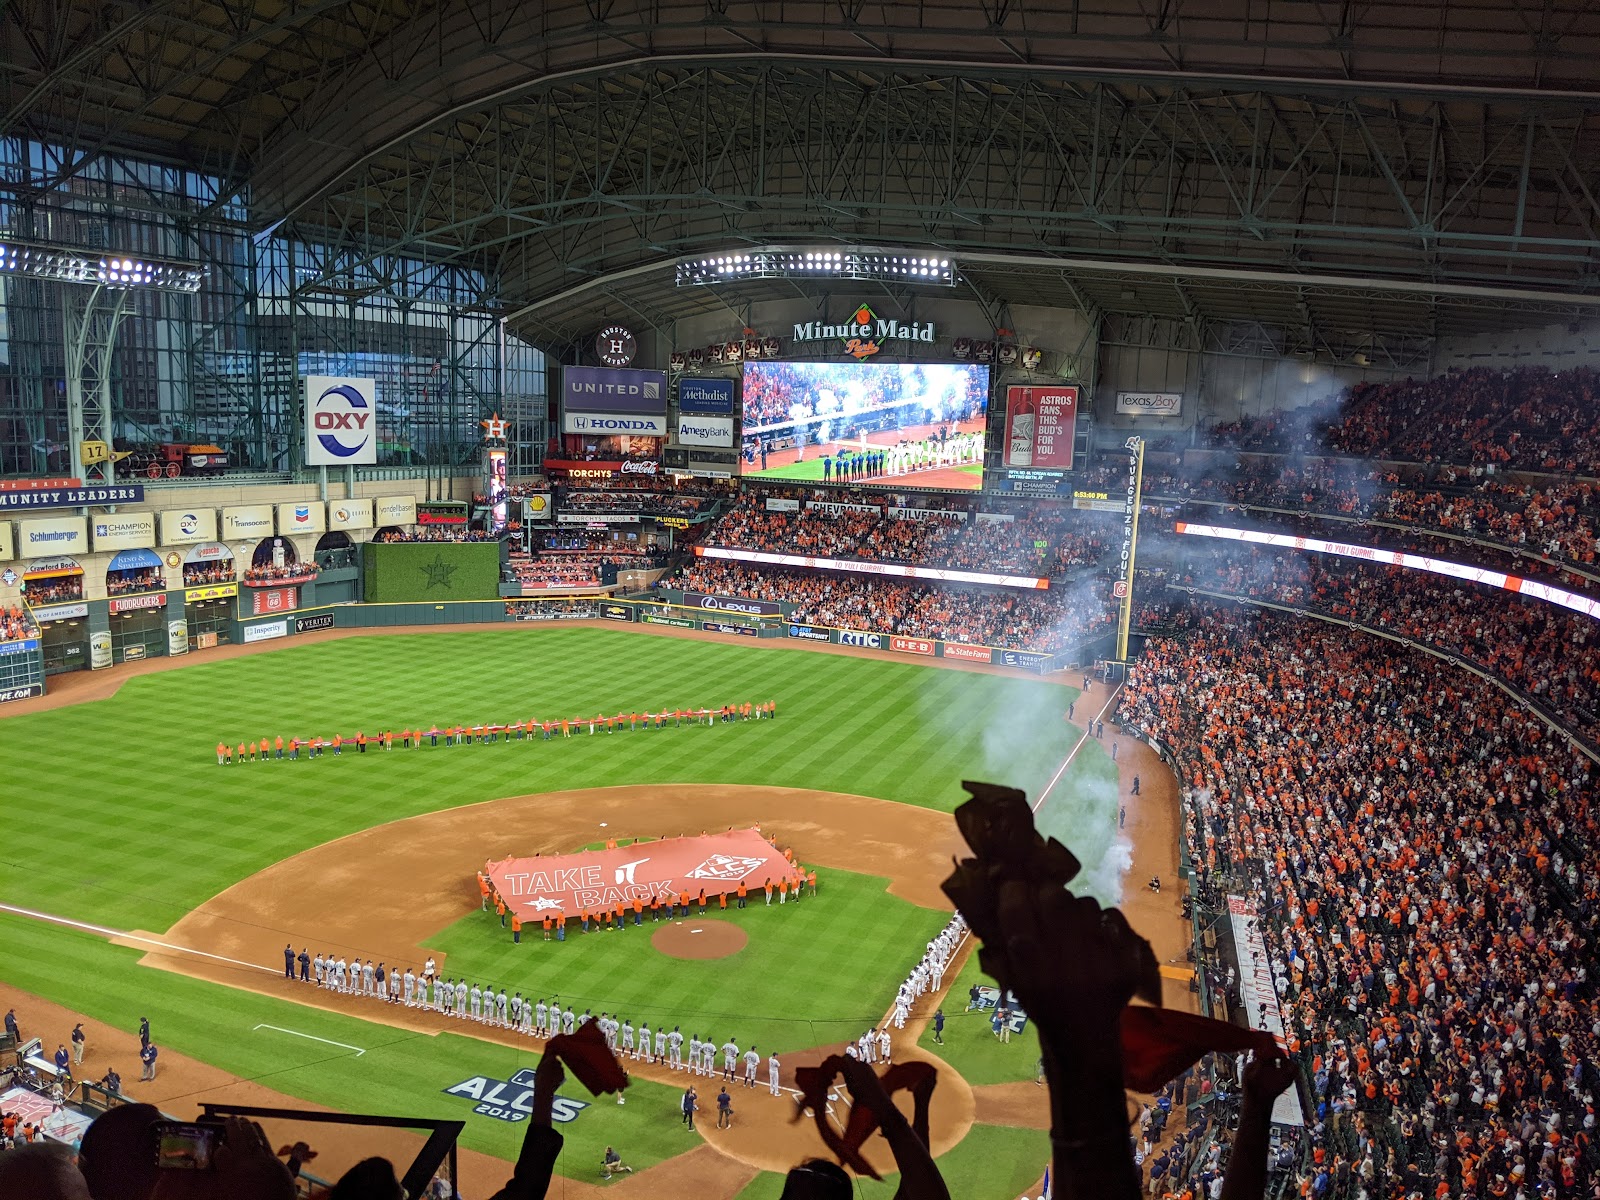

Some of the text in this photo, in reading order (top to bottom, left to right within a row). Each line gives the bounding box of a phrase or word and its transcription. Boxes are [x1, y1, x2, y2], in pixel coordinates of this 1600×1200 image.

[601, 327, 632, 340] HOUSTON
[792, 319, 935, 342] Minute Maid
[726, 341, 740, 352] 33
[745, 338, 758, 350] 34
[845, 339, 878, 355] Park
[1001, 342, 1010, 355] 5
[602, 354, 630, 365] ASTROS
[671, 353, 683, 364] 32
[1028, 348, 1035, 361] 7
[572, 382, 640, 395] UNITED
[683, 389, 729, 401] Methodist
[1040, 395, 1072, 405] ASTROS
[1121, 394, 1178, 410] Texas Bay
[1040, 406, 1063, 416] FANS,
[314, 412, 370, 430] OXY
[590, 419, 658, 430] HONDA
[1039, 416, 1058, 425] THIS
[1038, 426, 1062, 435] BUD'S
[1038, 436, 1053, 445] FOR
[87, 446, 102, 458] 17
[1037, 445, 1055, 455] YOU.
[569, 469, 612, 478] TORCHYS
[68, 489, 136, 502] LEADERS
[1096, 491, 1108, 499] PM
[108, 522, 151, 532] CHAMPION
[180, 520, 198, 528] OXY
[30, 531, 78, 543] Schlumberger
[1350, 547, 1375, 559] GURRIEL
[30, 563, 58, 572] Crawford
[844, 562, 859, 570] YULI
[860, 563, 886, 573] GURRIEL
[116, 595, 159, 611] FUDDRUCKERS
[718, 601, 762, 614] LEXUS
[305, 617, 332, 627] VERITEX
[254, 625, 281, 635] Insperity
[799, 631, 829, 640] SPORTSNET
[839, 631, 880, 647] RTIC
[694, 858, 762, 879] ALCS
[505, 865, 605, 896] TAKE
[574, 879, 681, 909] BACK
[447, 1076, 586, 1122] ALCS
[475, 1104, 525, 1121] 2019
